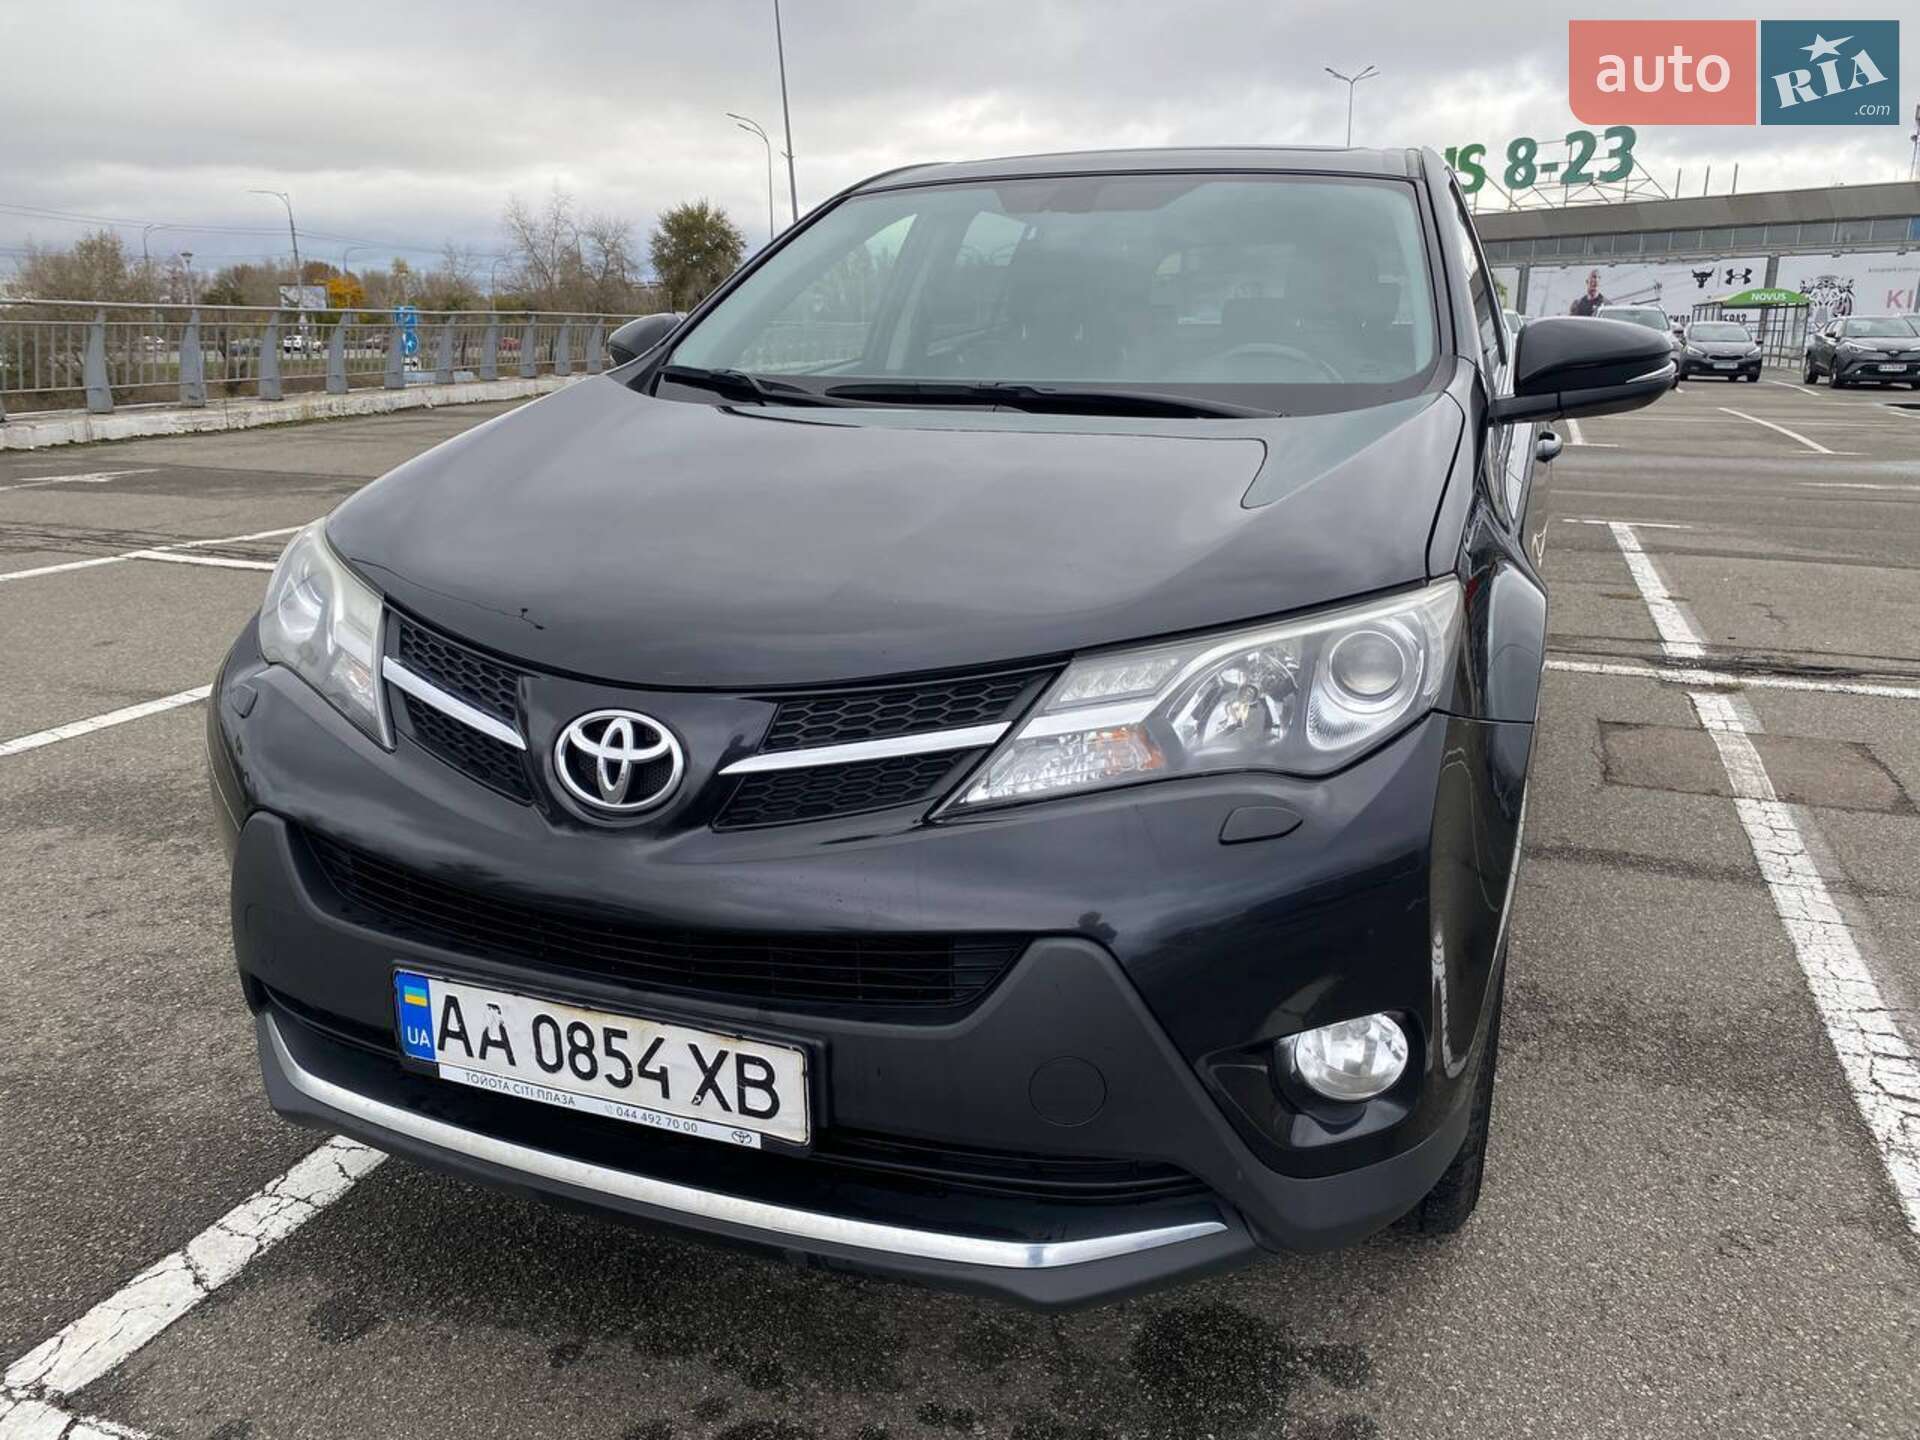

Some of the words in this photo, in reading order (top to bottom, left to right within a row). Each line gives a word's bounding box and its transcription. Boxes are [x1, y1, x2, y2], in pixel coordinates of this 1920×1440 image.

[1504, 125, 1637, 190] 8-23
[1751, 292, 1787, 302] NOVUS
[407, 1025, 431, 1049] UA
[531, 1013, 670, 1100] 0854
[688, 1042, 781, 1121] XB
[537, 1087, 576, 1107] ПЛАЗА
[616, 1108, 639, 1121] 044
[641, 1112, 662, 1126] 492
[665, 1118, 680, 1130] 70
[682, 1121, 698, 1134] 00
